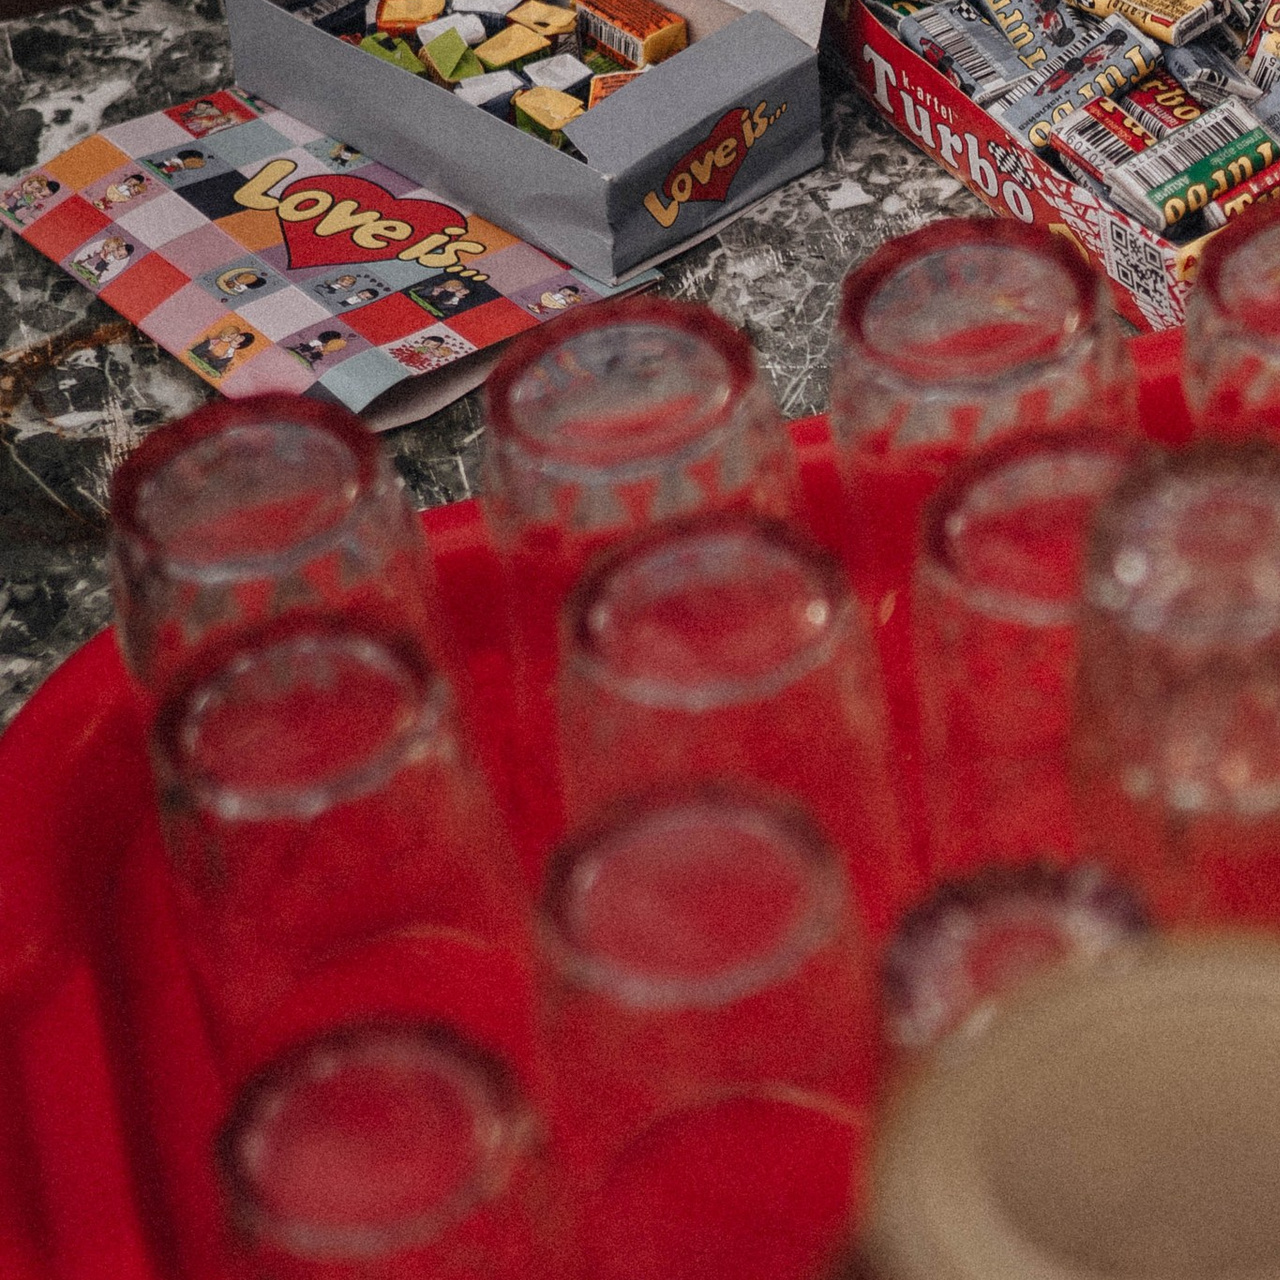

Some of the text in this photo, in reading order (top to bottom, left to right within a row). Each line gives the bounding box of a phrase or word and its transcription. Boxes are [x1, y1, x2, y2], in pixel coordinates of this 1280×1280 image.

[863, 43, 1035, 224] Turbo
[1018, 95, 1063, 131] наклейка
[233, 158, 417, 253] Love
[643, 138, 738, 229] Love
